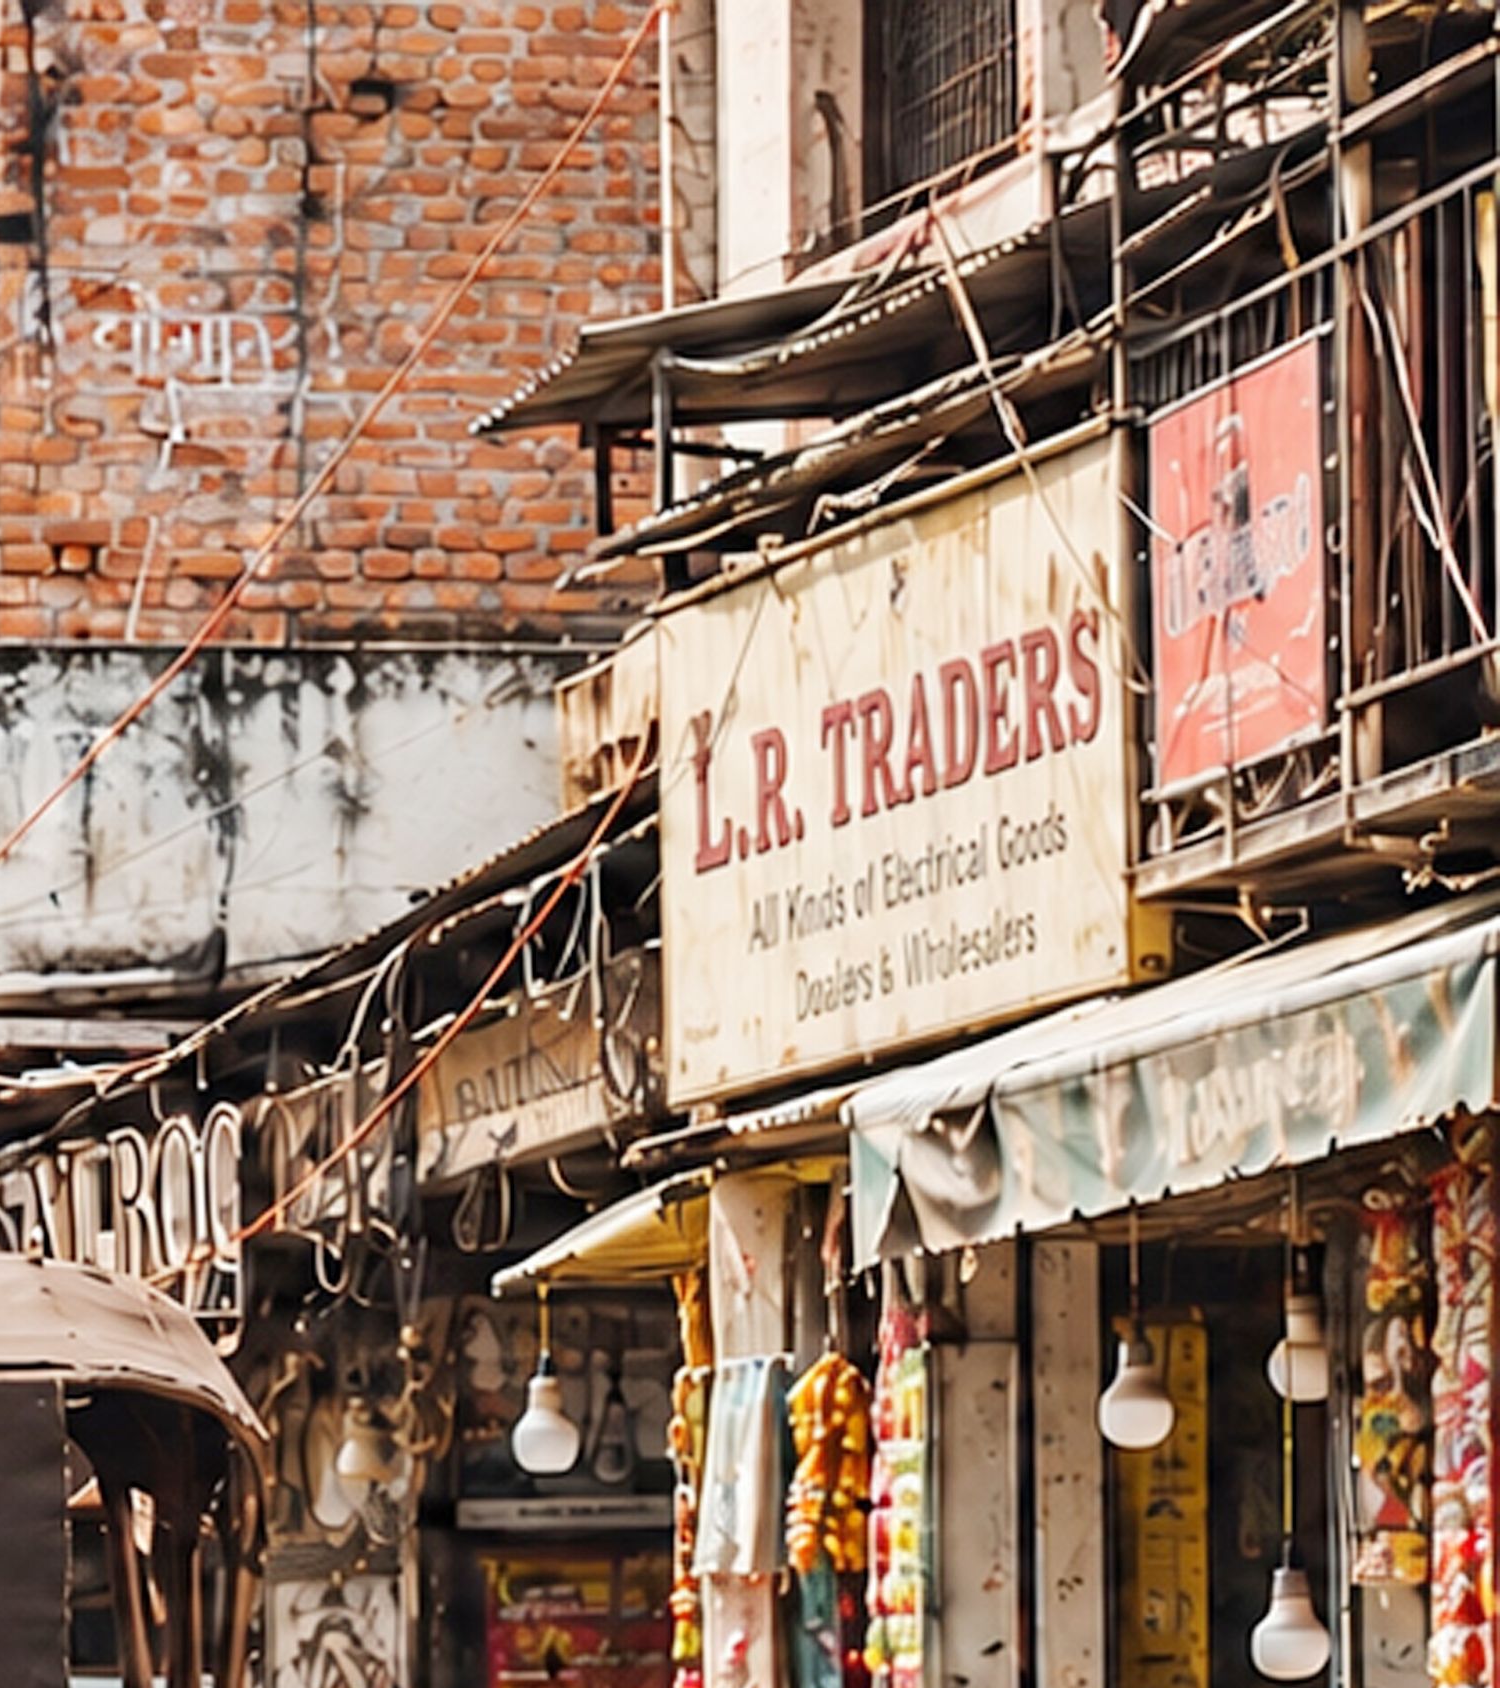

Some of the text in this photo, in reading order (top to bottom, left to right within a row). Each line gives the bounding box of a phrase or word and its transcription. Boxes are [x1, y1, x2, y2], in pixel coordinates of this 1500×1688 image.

[694, 607, 1103, 876] L.R. TRADERS
[749, 893, 780, 955] All
[853, 860, 876, 919] of
[882, 822, 988, 909] Electrical
[996, 801, 1068, 871] Goods
[794, 957, 873, 1023] Dealers
[903, 906, 1038, 988] Wholesalers
